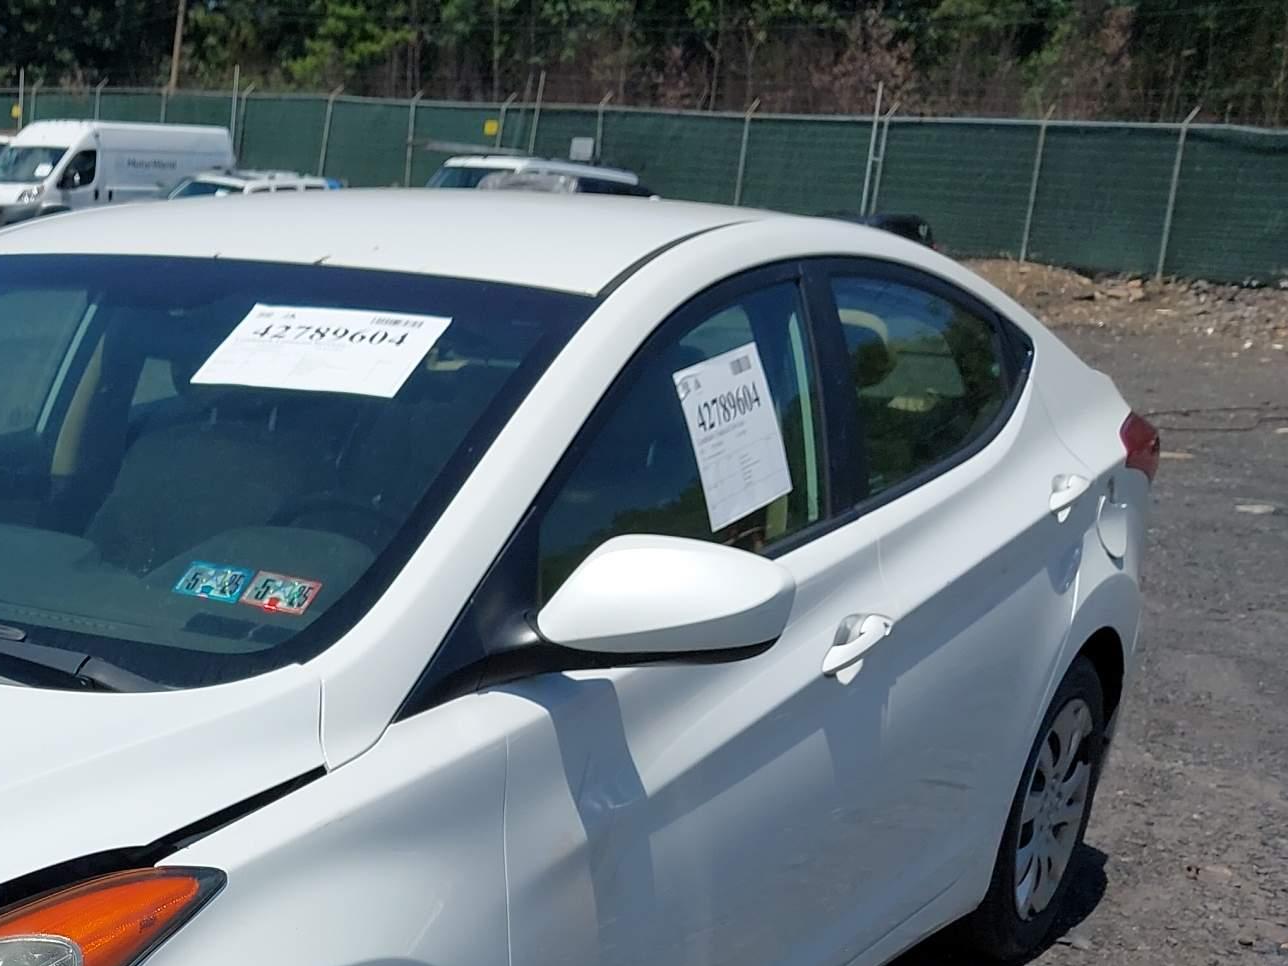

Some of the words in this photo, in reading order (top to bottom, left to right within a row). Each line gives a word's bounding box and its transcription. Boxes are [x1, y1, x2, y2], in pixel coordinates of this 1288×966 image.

[252, 324, 409, 347] 42789604
[697, 382, 761, 432] 42789604
[186, 572, 200, 591] 5
[254, 578, 276, 600] 5
